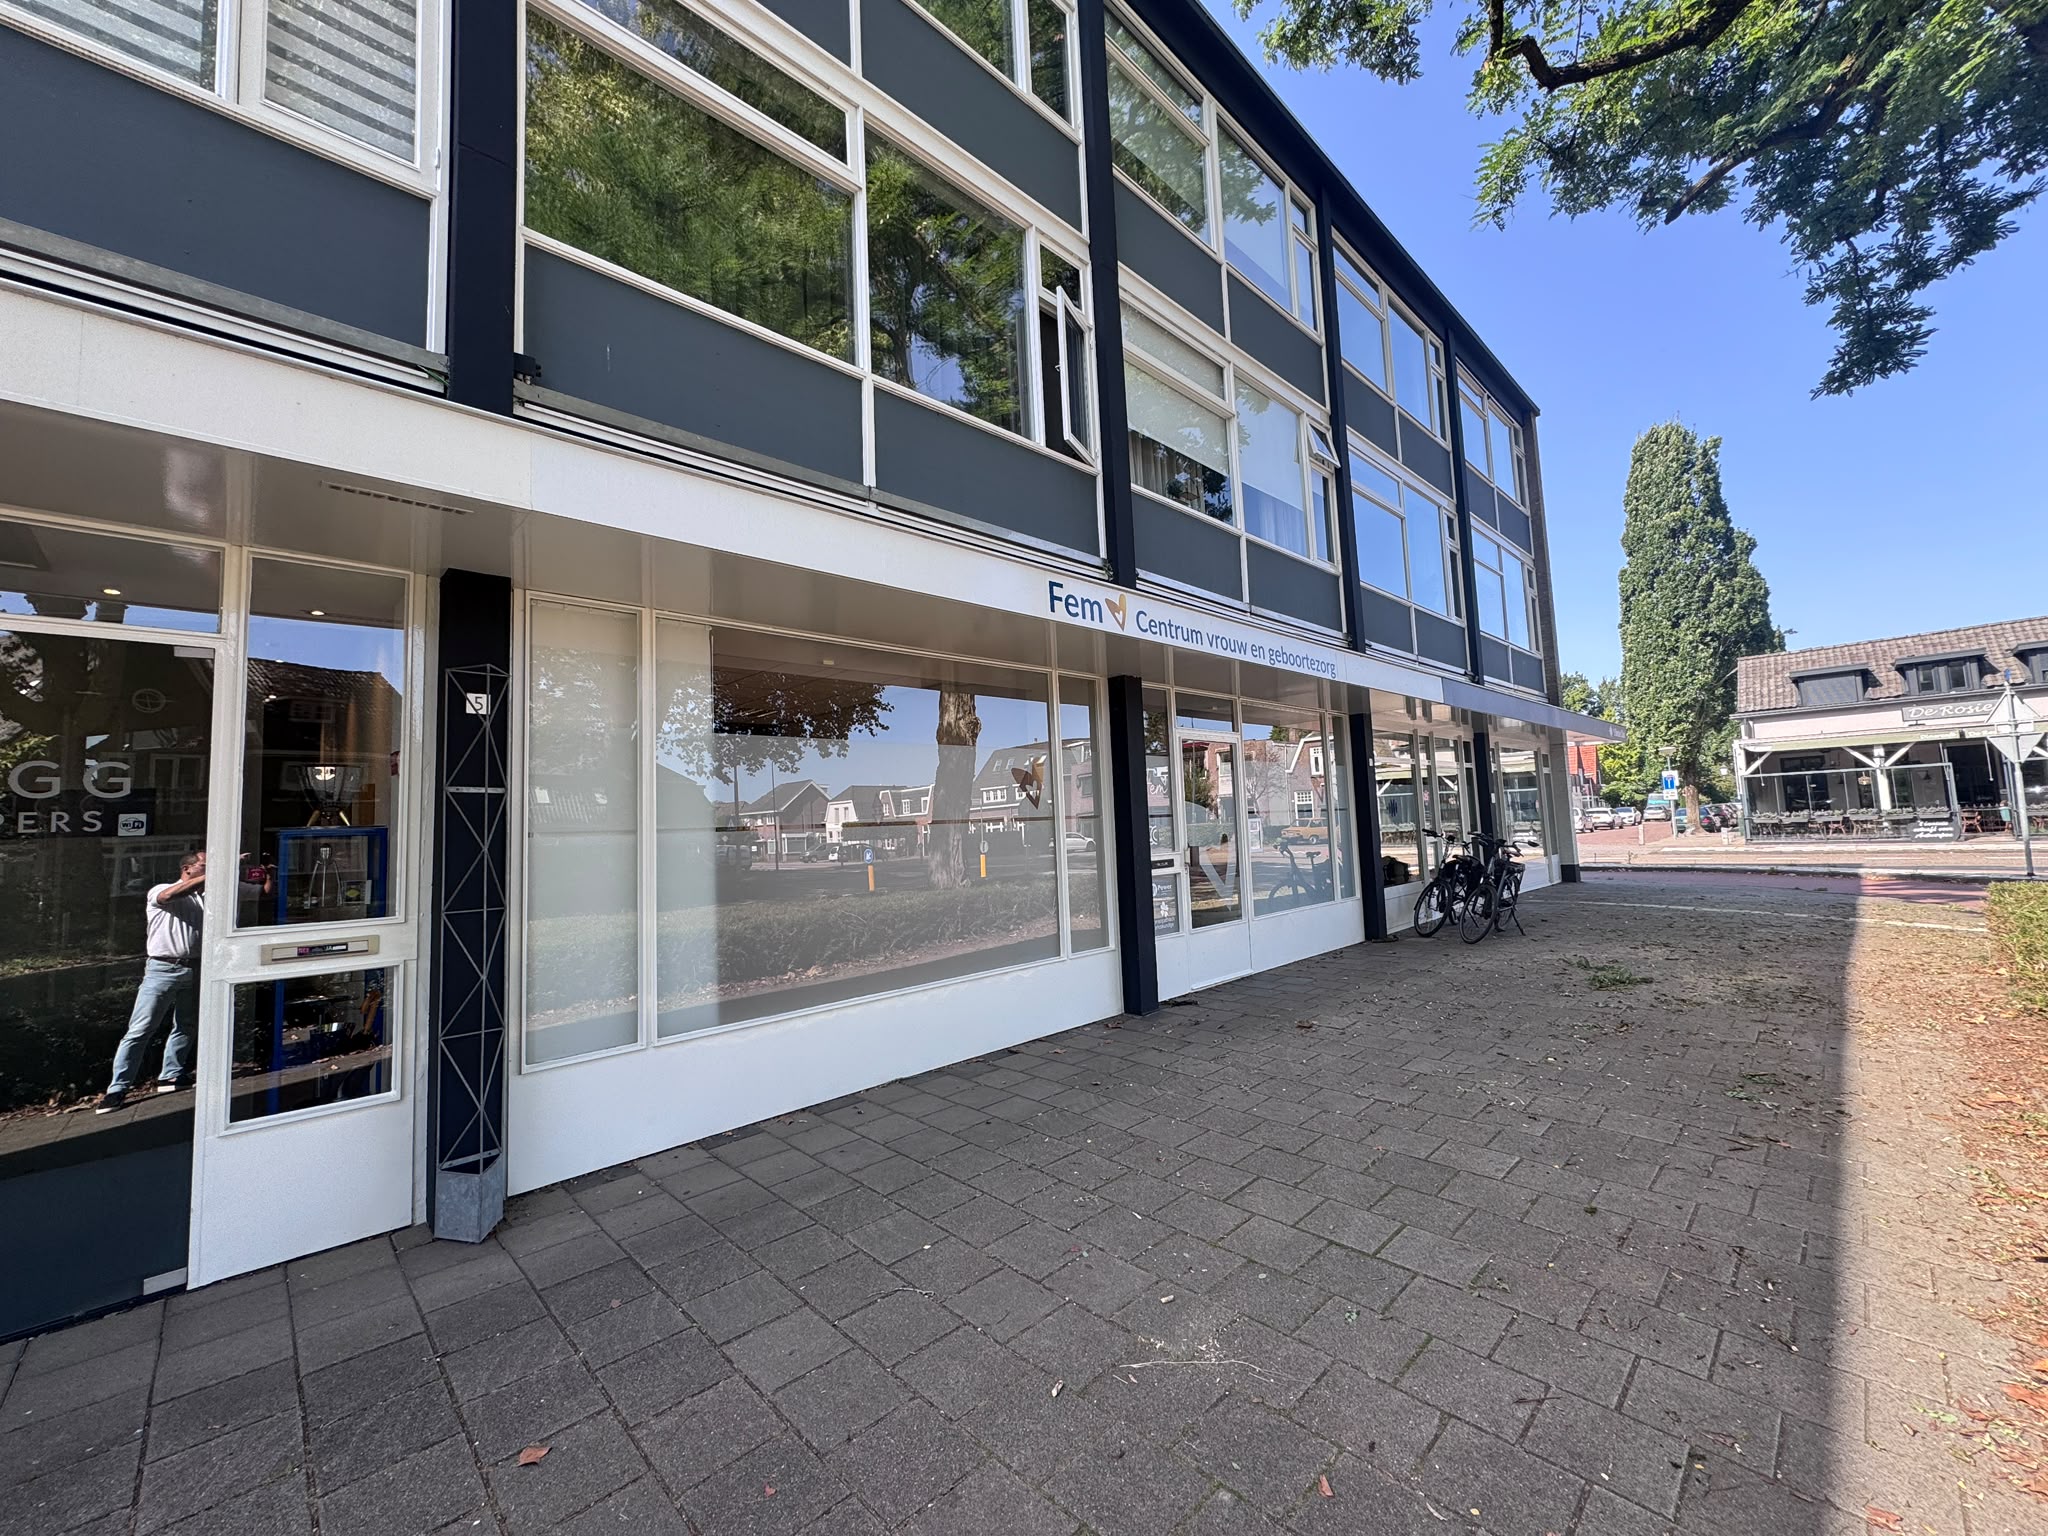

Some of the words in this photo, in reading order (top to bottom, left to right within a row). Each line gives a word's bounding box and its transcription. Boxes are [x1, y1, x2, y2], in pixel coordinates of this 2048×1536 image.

[1048, 580, 1104, 623] Fem
[1135, 610, 1204, 646] Centrum
[1206, 632, 1248, 656] vrouw
[1250, 643, 1266, 660] en
[1268, 645, 1337, 679] geboortezorg
[474, 696, 484, 711] 5
[1908, 706, 1938, 718] De
[7, 760, 132, 799] GG
[0, 810, 103, 834] ERS
